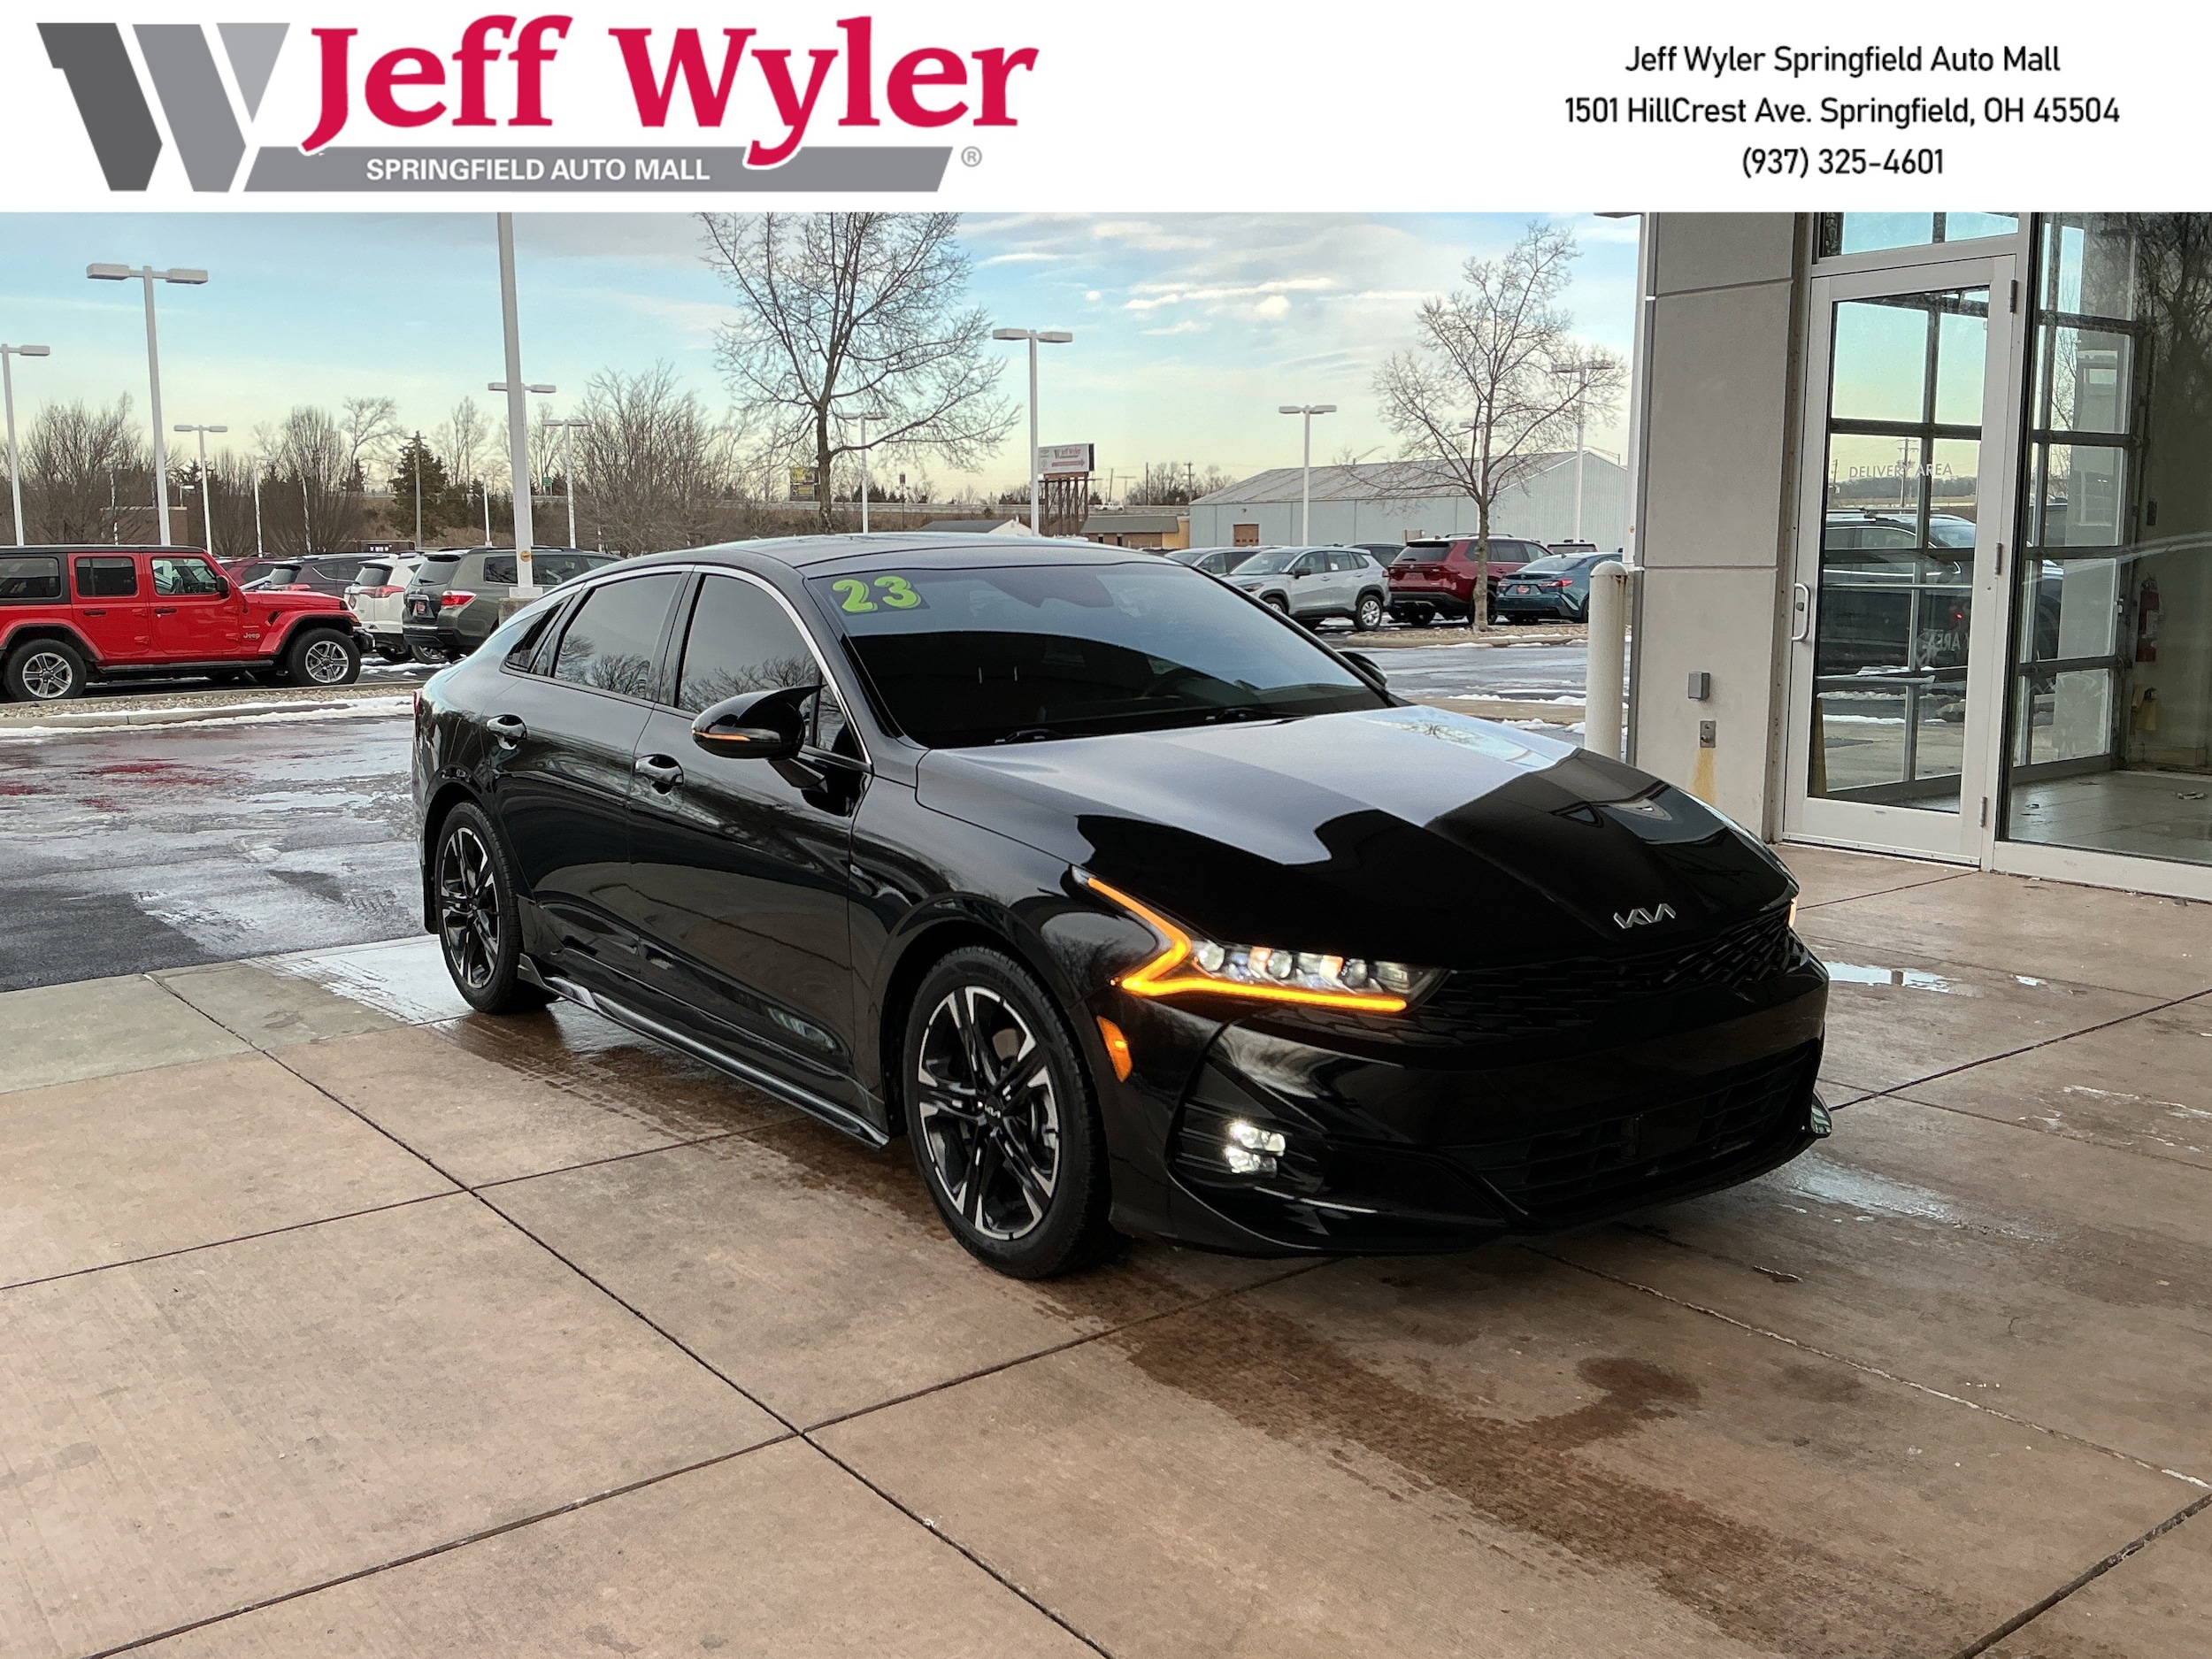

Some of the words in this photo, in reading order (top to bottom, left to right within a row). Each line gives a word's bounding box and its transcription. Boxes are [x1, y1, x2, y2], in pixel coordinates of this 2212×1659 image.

[1849, 465, 1909, 478] DELIVERY
[1916, 463, 1953, 477] AREA
[832, 576, 922, 614] 23
[1612, 902, 1677, 930] KIA
